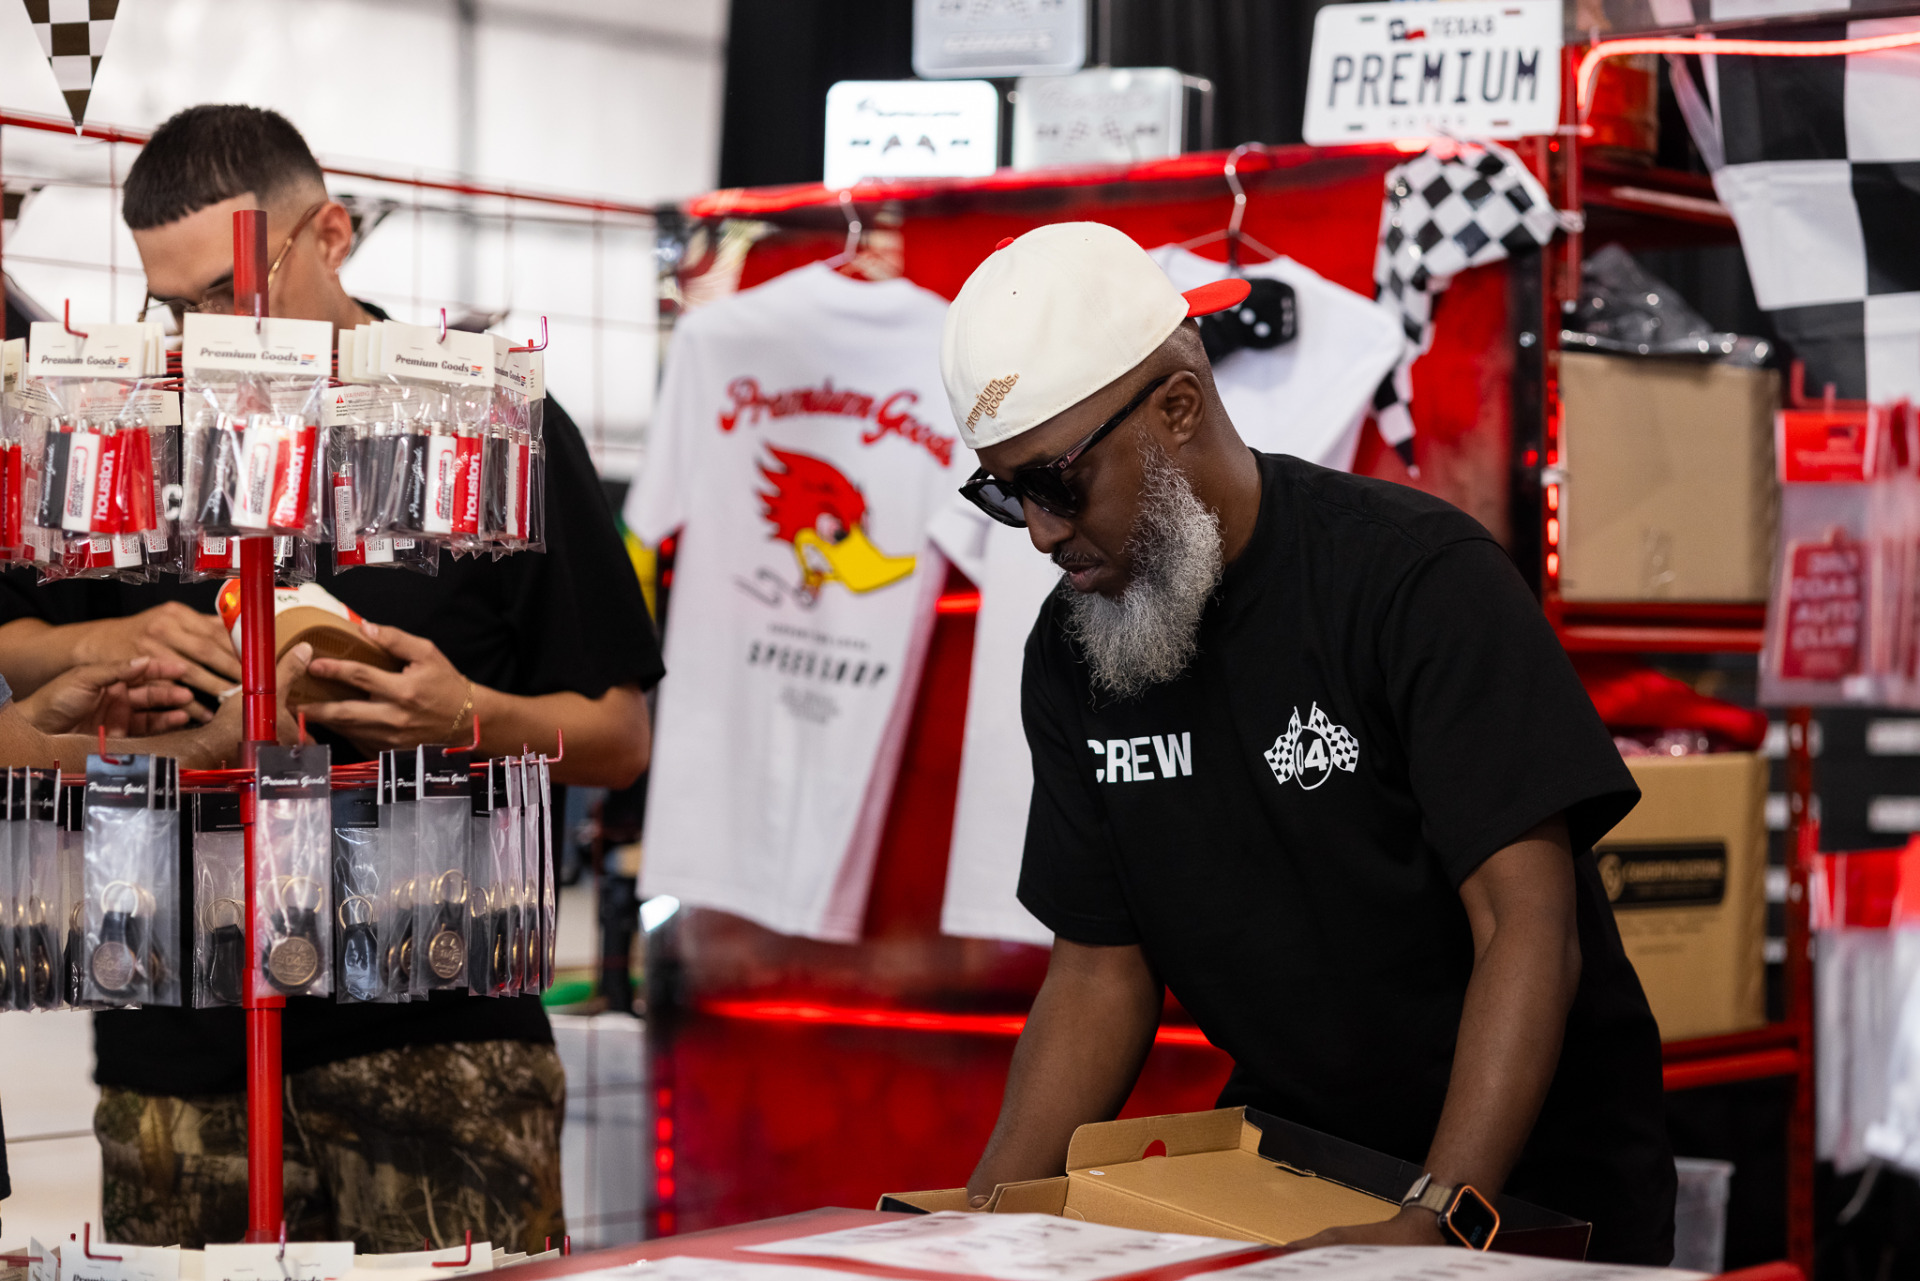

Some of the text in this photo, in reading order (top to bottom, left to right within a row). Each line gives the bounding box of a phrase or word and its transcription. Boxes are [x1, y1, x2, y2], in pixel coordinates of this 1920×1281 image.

[1327, 49, 1539, 108] PREMIUM
[41, 354, 116, 366] Premium Goods
[199, 347, 299, 362] Premium Goods
[395, 354, 470, 373] Premium Goods
[965, 377, 1001, 434] premium
